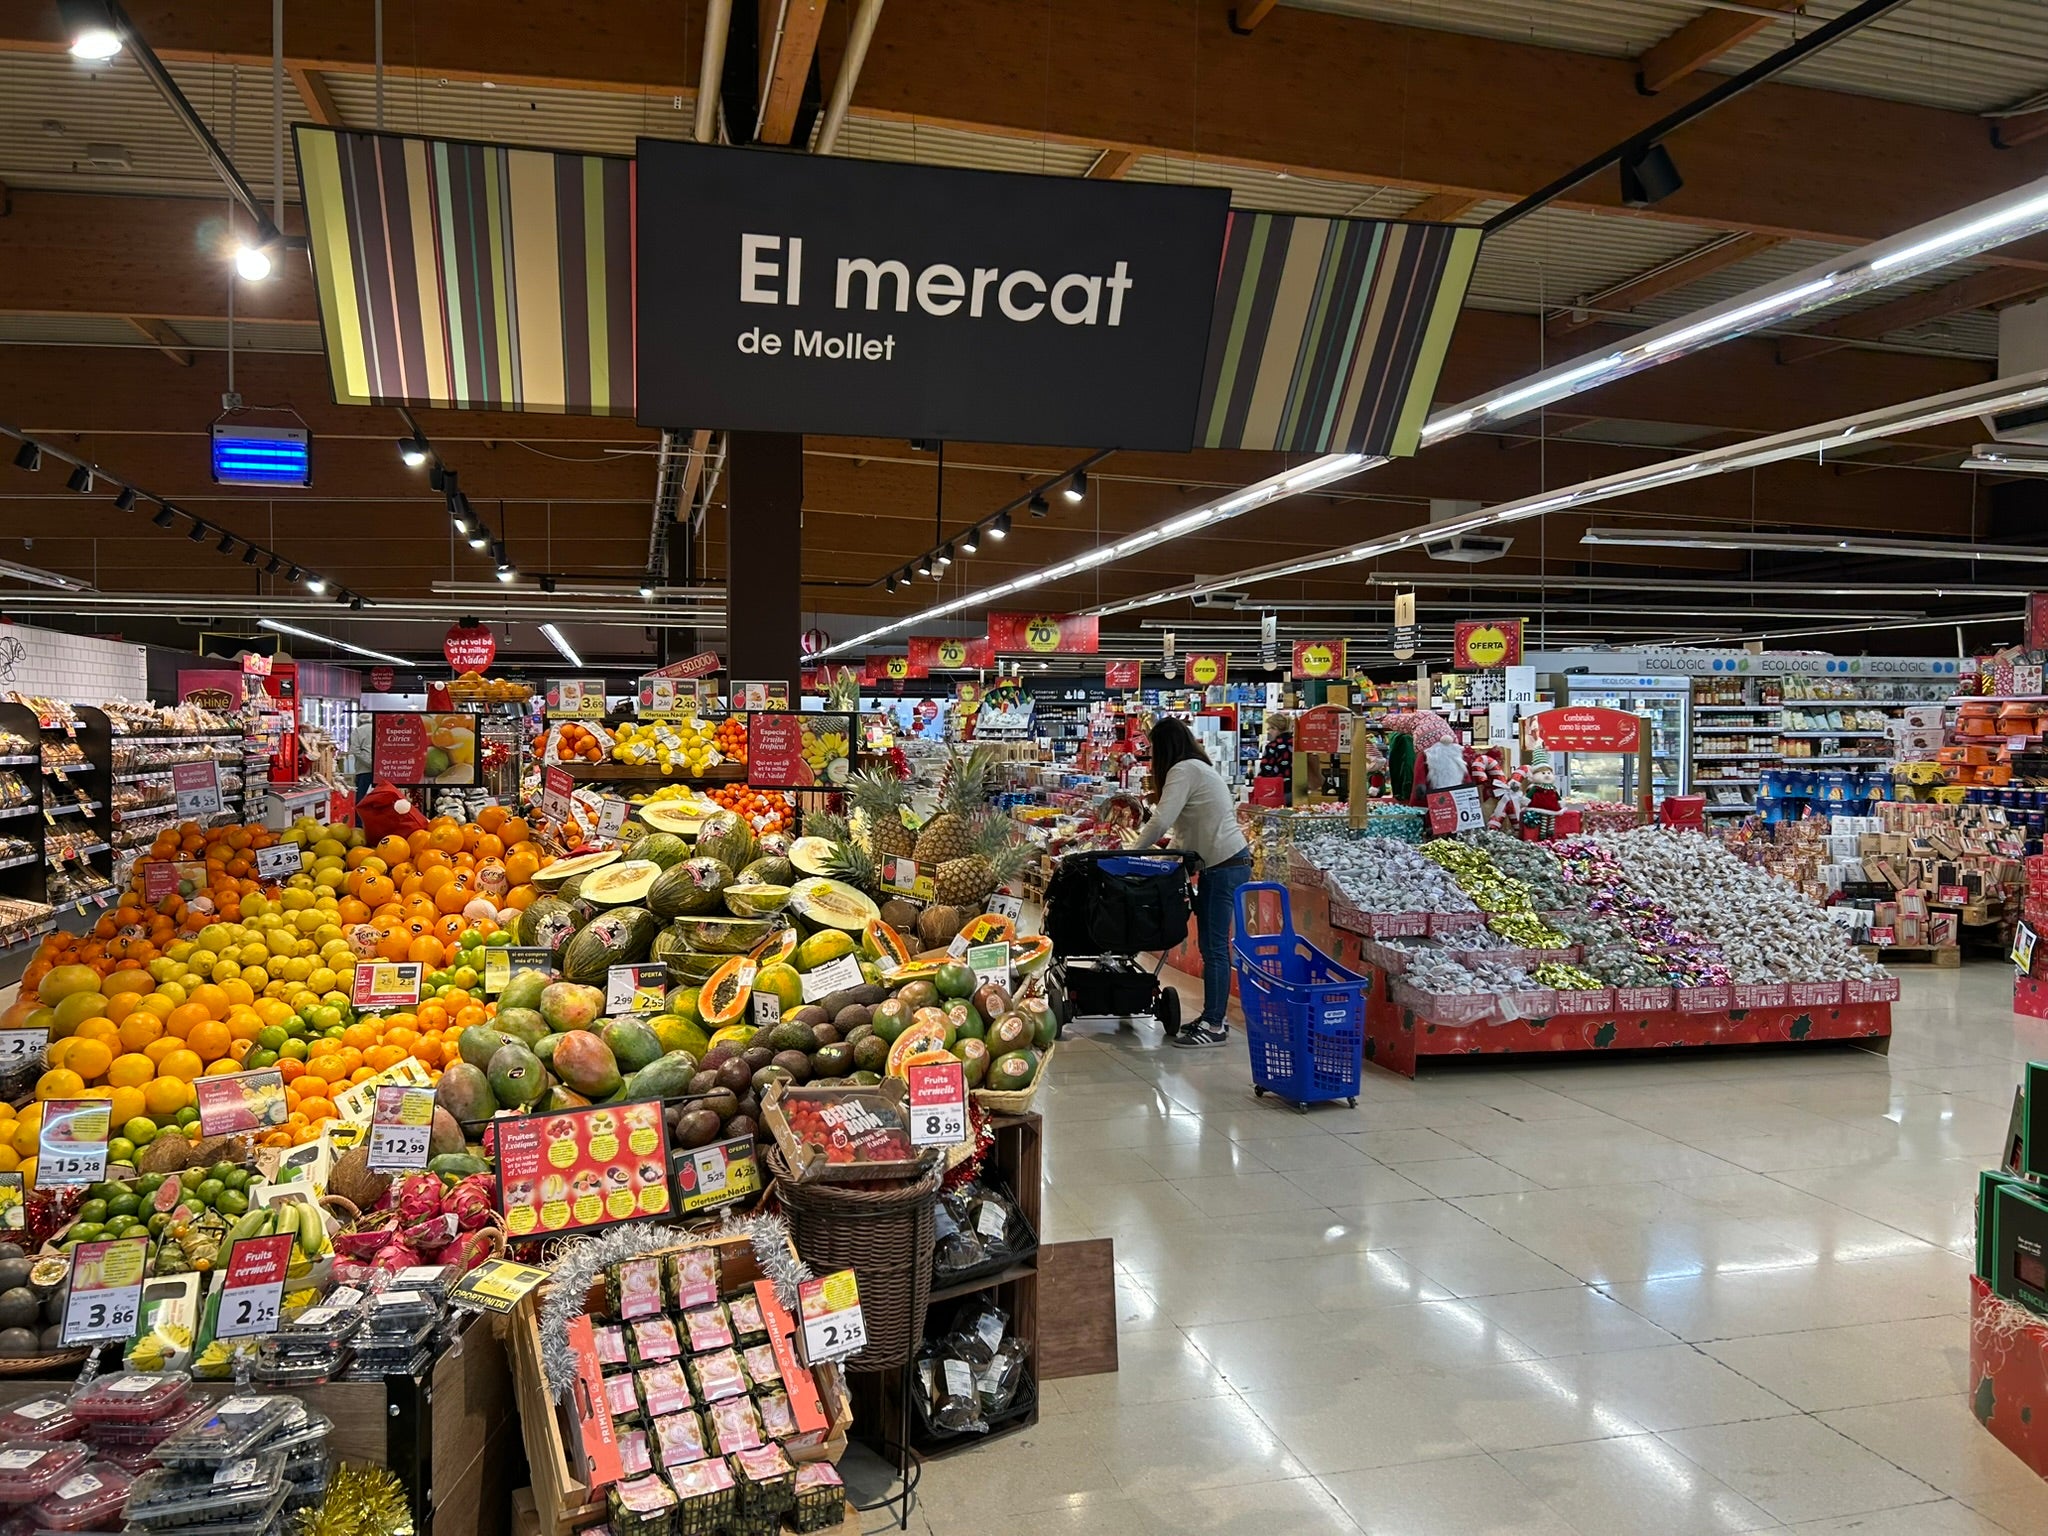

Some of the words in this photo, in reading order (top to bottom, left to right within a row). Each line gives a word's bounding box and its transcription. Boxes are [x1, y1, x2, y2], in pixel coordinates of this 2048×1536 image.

[739, 233, 802, 306] El
[835, 259, 1133, 326] mercat
[736, 326, 782, 356] de
[793, 329, 895, 361] Mollet
[1402, 602, 1407, 619] 1
[1266, 623, 1272, 637] 2
[1469, 642, 1504, 650] OFERTA
[461, 656, 487, 665] Nadal
[1508, 689, 1531, 702] Lan
[582, 697, 604, 708] 3,69
[674, 698, 697, 709] 2,40
[386, 728, 412, 736] Especial
[1491, 725, 1506, 738] Lan
[189, 795, 216, 808] 4,25
[1460, 810, 1481, 822] 0,59
[604, 822, 619, 832] 2,99
[272, 854, 299, 867] 2,99
[998, 903, 1017, 919] 169
[614, 995, 633, 1006] 2,99
[642, 996, 664, 1009] 2,59
[762, 1002, 779, 1020] 5,45
[924, 1076, 949, 1085] Fruits
[918, 1084, 955, 1096] vermells
[819, 1099, 868, 1128] BERRY
[842, 1112, 884, 1136] BOOM
[926, 1116, 961, 1136] 8,99
[507, 1133, 534, 1142] Fruites
[386, 1139, 425, 1156] 12,99
[727, 1143, 750, 1154] OFERTA
[55, 1158, 100, 1174] 15,28
[734, 1167, 756, 1178] 4,25
[706, 1173, 725, 1183] 5,25
[690, 1193, 727, 1208] Ofertassa
[727, 1183, 754, 1197] Nadal
[245, 1251, 273, 1262] Fruits
[234, 1261, 278, 1277] vermells
[453, 1289, 510, 1309] OPORTUNITAT
[626, 1292, 653, 1302] PRIMICIA
[87, 1303, 134, 1329] 3,86
[236, 1300, 275, 1326] 2,25
[766, 1311, 785, 1354] PRIMICIA
[823, 1326, 862, 1347] 2,25
[654, 1387, 680, 1398] PRIMICIA
[595, 1395, 612, 1445] PRIMICIA
